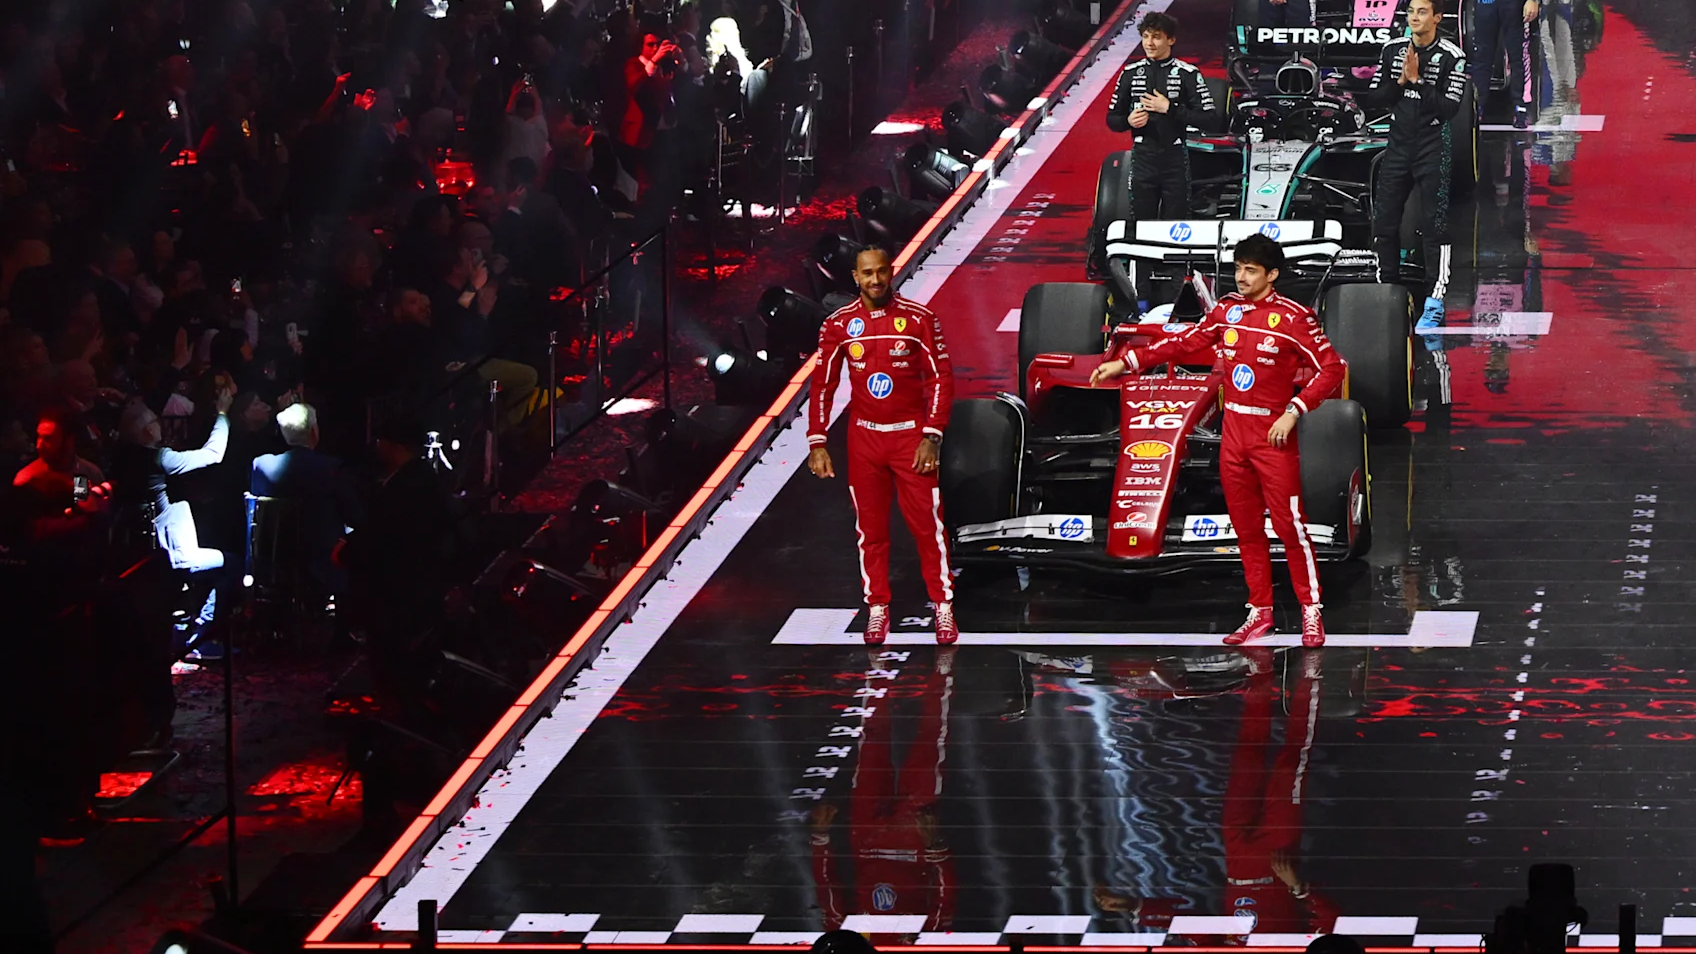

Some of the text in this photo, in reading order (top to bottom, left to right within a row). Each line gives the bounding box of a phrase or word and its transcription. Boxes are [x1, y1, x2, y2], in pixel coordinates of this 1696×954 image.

[1258, 28, 1391, 45] PETRONAS
[1171, 222, 1191, 242] hp
[1260, 223, 1280, 241] hp
[847, 318, 864, 337] hp
[868, 372, 893, 399] hp
[1233, 364, 1254, 391] hp
[1126, 400, 1196, 408] VGW
[1128, 414, 1183, 430] 16
[1130, 463, 1161, 473] aws
[1124, 477, 1162, 485] IBM
[1060, 518, 1084, 537] hp
[1193, 518, 1218, 537] hp
